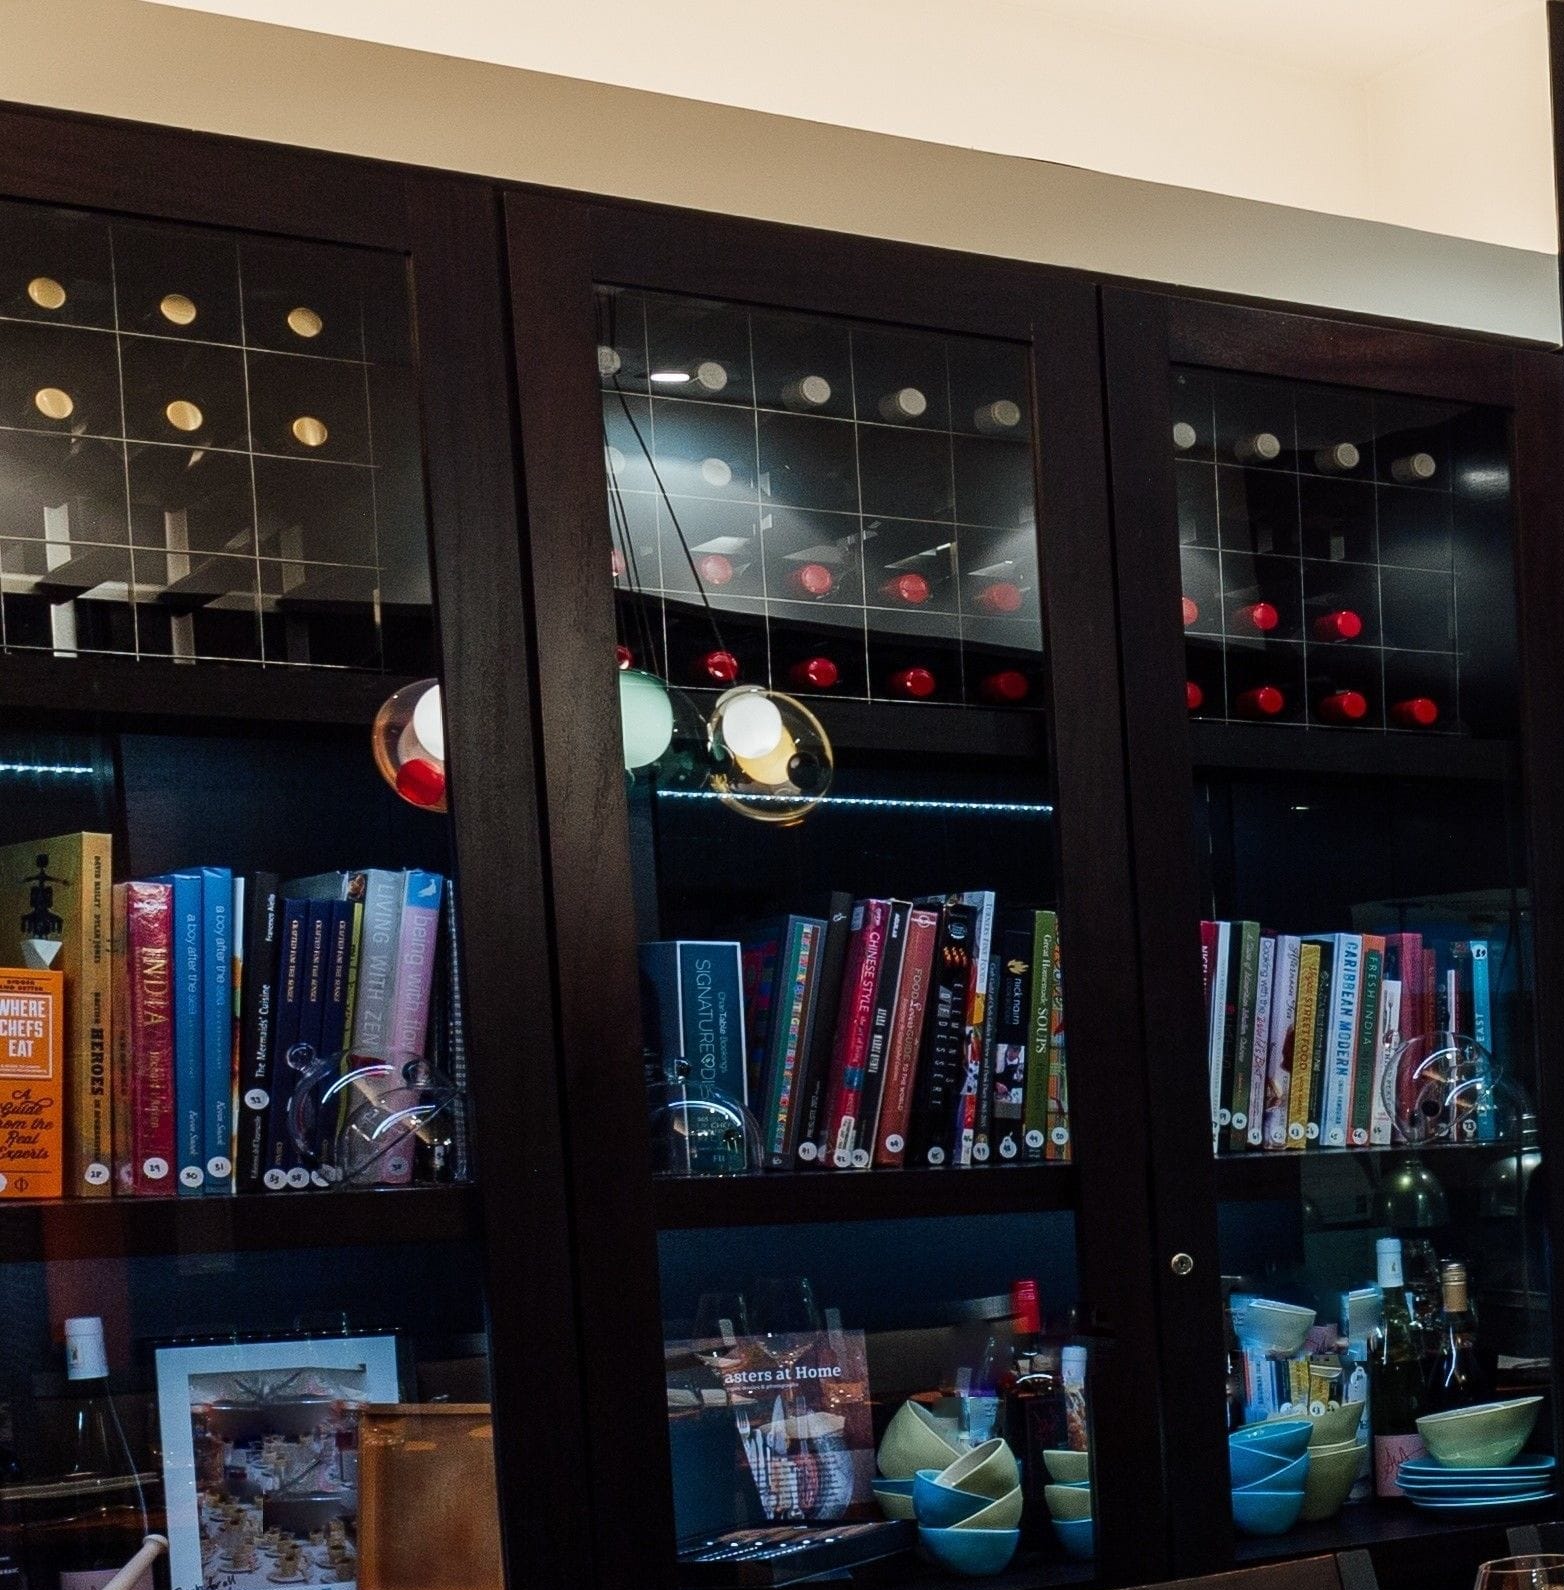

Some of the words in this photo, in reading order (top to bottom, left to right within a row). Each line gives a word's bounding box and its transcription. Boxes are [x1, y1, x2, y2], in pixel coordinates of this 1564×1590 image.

[213, 914, 225, 937] boy
[373, 883, 393, 944] LIVING
[185, 923, 197, 945] boy
[405, 915, 428, 966] being
[1041, 934, 1052, 958] Great
[187, 946, 198, 972] after
[215, 938, 226, 963] after
[864, 932, 882, 978] CHINESE
[1259, 940, 1272, 977] Cooking
[142, 946, 168, 1027] INDIA
[187, 974, 198, 993] the
[215, 965, 226, 983] the
[368, 954, 388, 1001] WITH
[910, 968, 923, 999] FOOD
[1011, 976, 1022, 997] nick
[1039, 959, 1051, 1004] Homemade
[1258, 979, 1269, 998] with
[1340, 942, 1358, 1017] CARIBBEAN
[1367, 955, 1378, 998] FRESH
[0, 999, 46, 1018] WHERE
[259, 984, 270, 1014] Cuisine
[695, 959, 715, 1053] SIGNATURE
[858, 979, 874, 1013] STYLE
[1258, 999, 1268, 1015] the
[1010, 999, 1021, 1025] nairn
[1301, 997, 1312, 1036] STREET
[1363, 1004, 1374, 1046] INDIA
[1475, 1012, 1485, 1042] EAST
[0, 1019, 44, 1038] CHEFS
[362, 1010, 382, 1048] ZEN
[945, 982, 963, 1083] ELEMENTS
[1035, 1007, 1048, 1054] SOUPS
[9, 1039, 34, 1057] EAT
[903, 1029, 914, 1060] GUIDE
[1299, 1038, 1310, 1071] FOOD
[1336, 1019, 1352, 1076] MODERN
[90, 1028, 104, 1096] HEROES
[255, 1062, 266, 1078] The
[931, 1021, 948, 1105] DESSERT
[0, 1097, 54, 1118] Guide
[12, 1088, 32, 1100] A
[31, 1117, 54, 1130] the
[6, 1130, 40, 1148] Real
[724, 1370, 773, 1384] asters
[775, 1368, 792, 1381] at
[795, 1365, 842, 1380] Home
